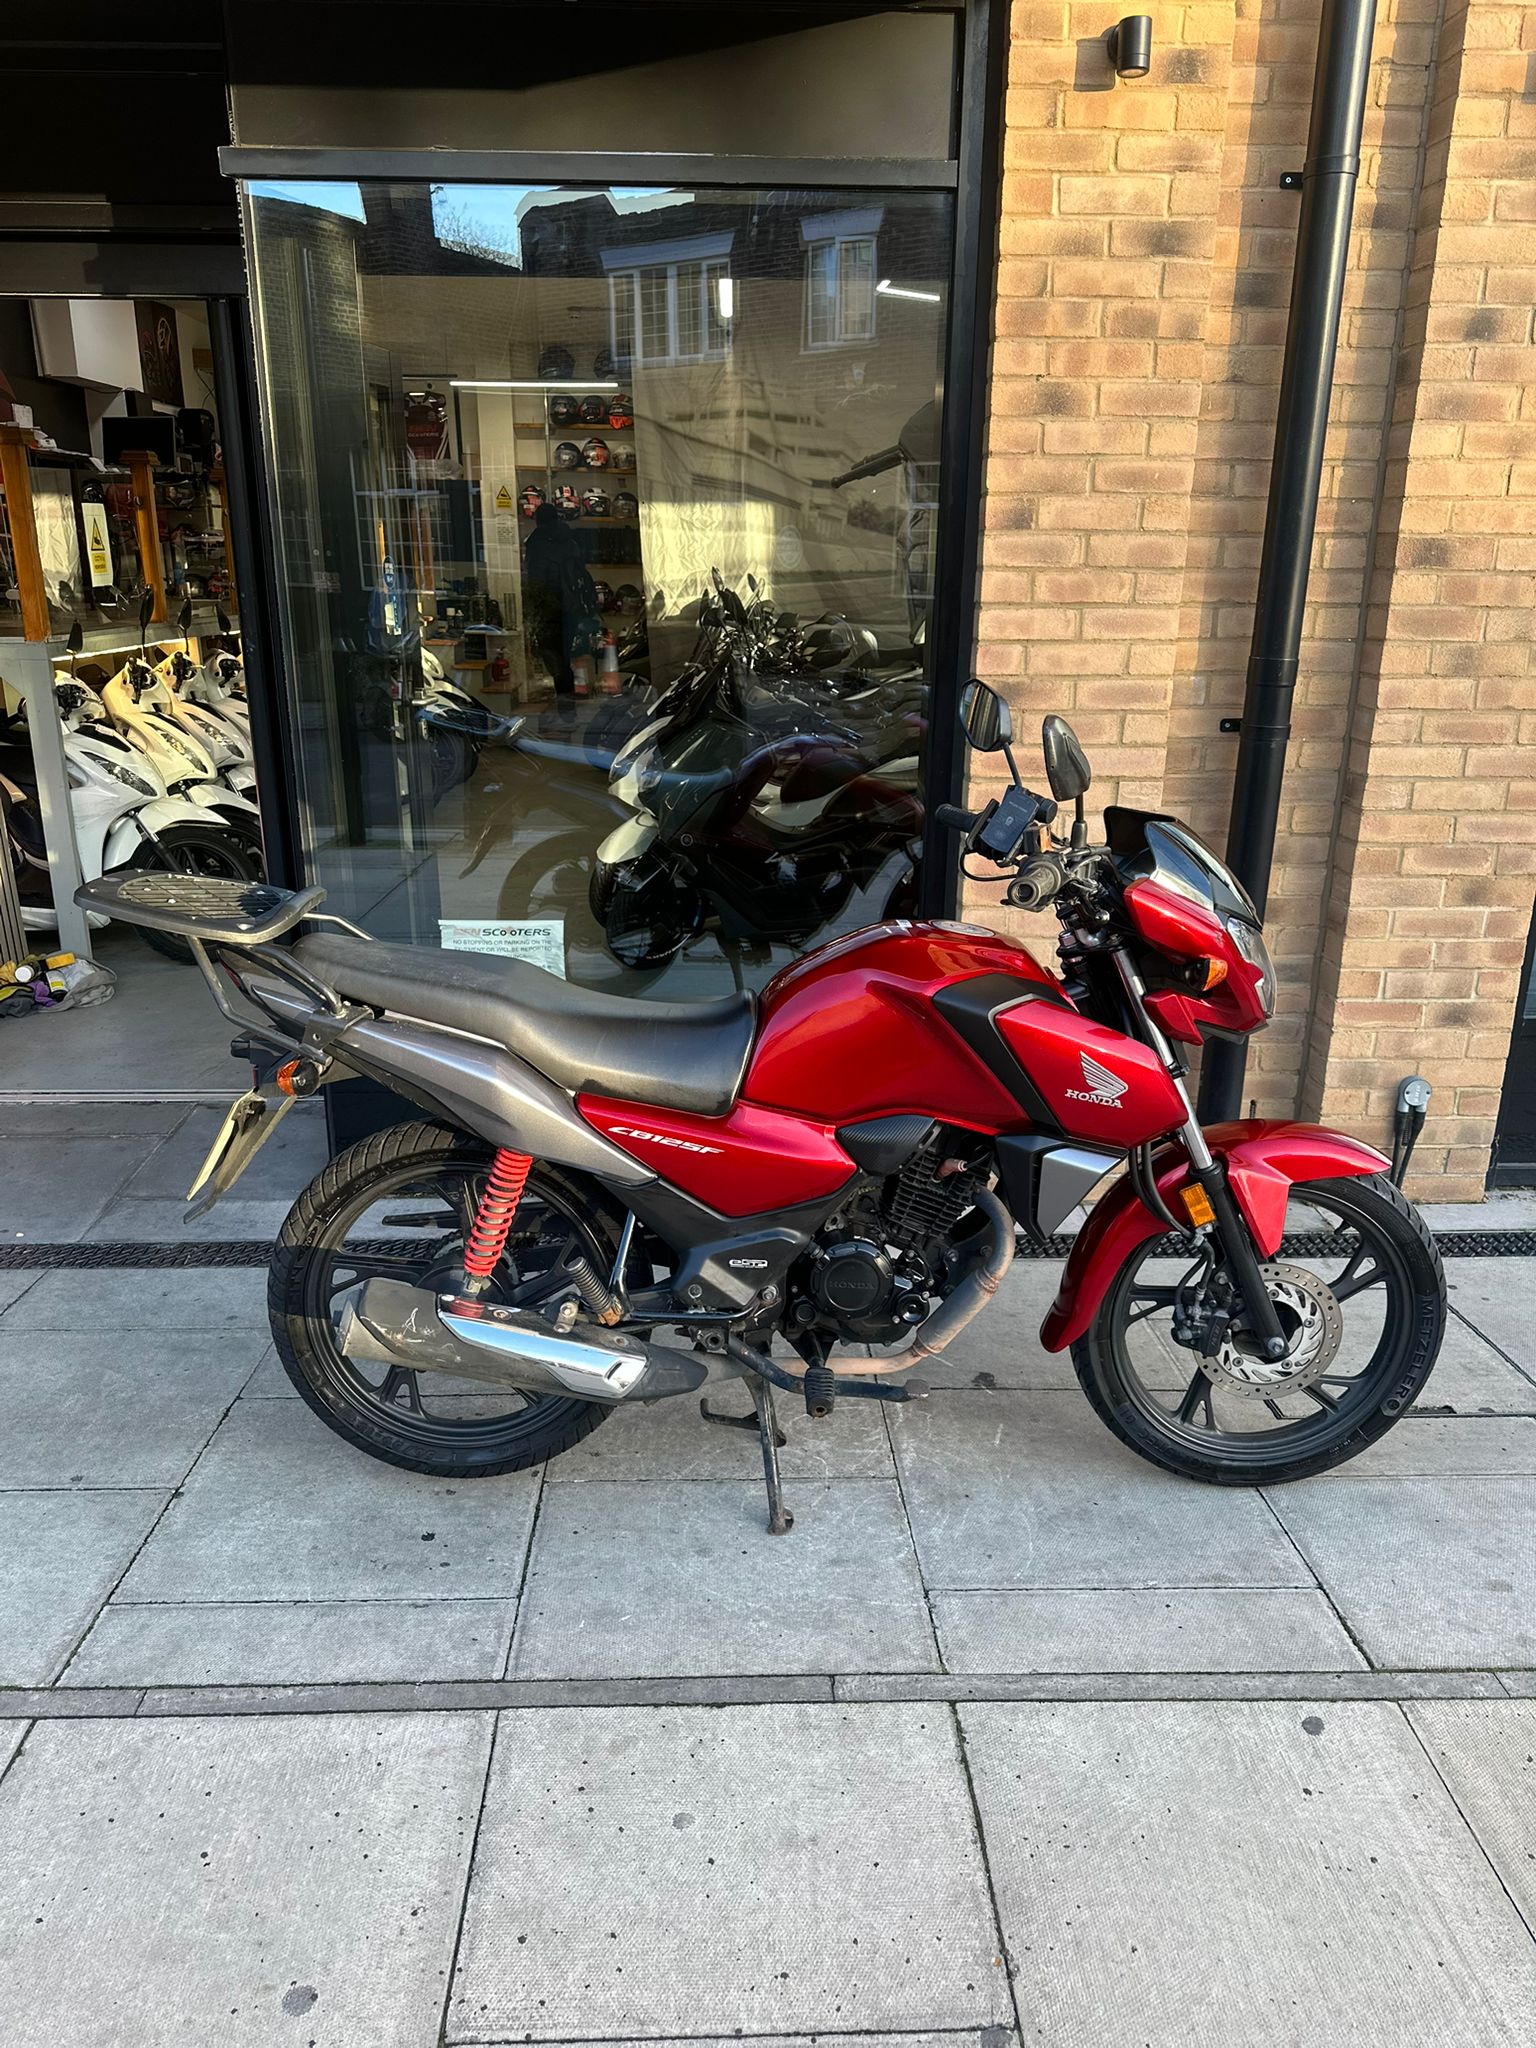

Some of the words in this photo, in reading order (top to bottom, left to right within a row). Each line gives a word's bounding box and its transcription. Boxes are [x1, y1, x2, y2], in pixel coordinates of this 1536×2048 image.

[1065, 1089, 1123, 1109] HONDA
[608, 1122, 725, 1154] CB125F
[829, 1279, 876, 1290] HONDA
[1396, 1297, 1434, 1399] METZELER
